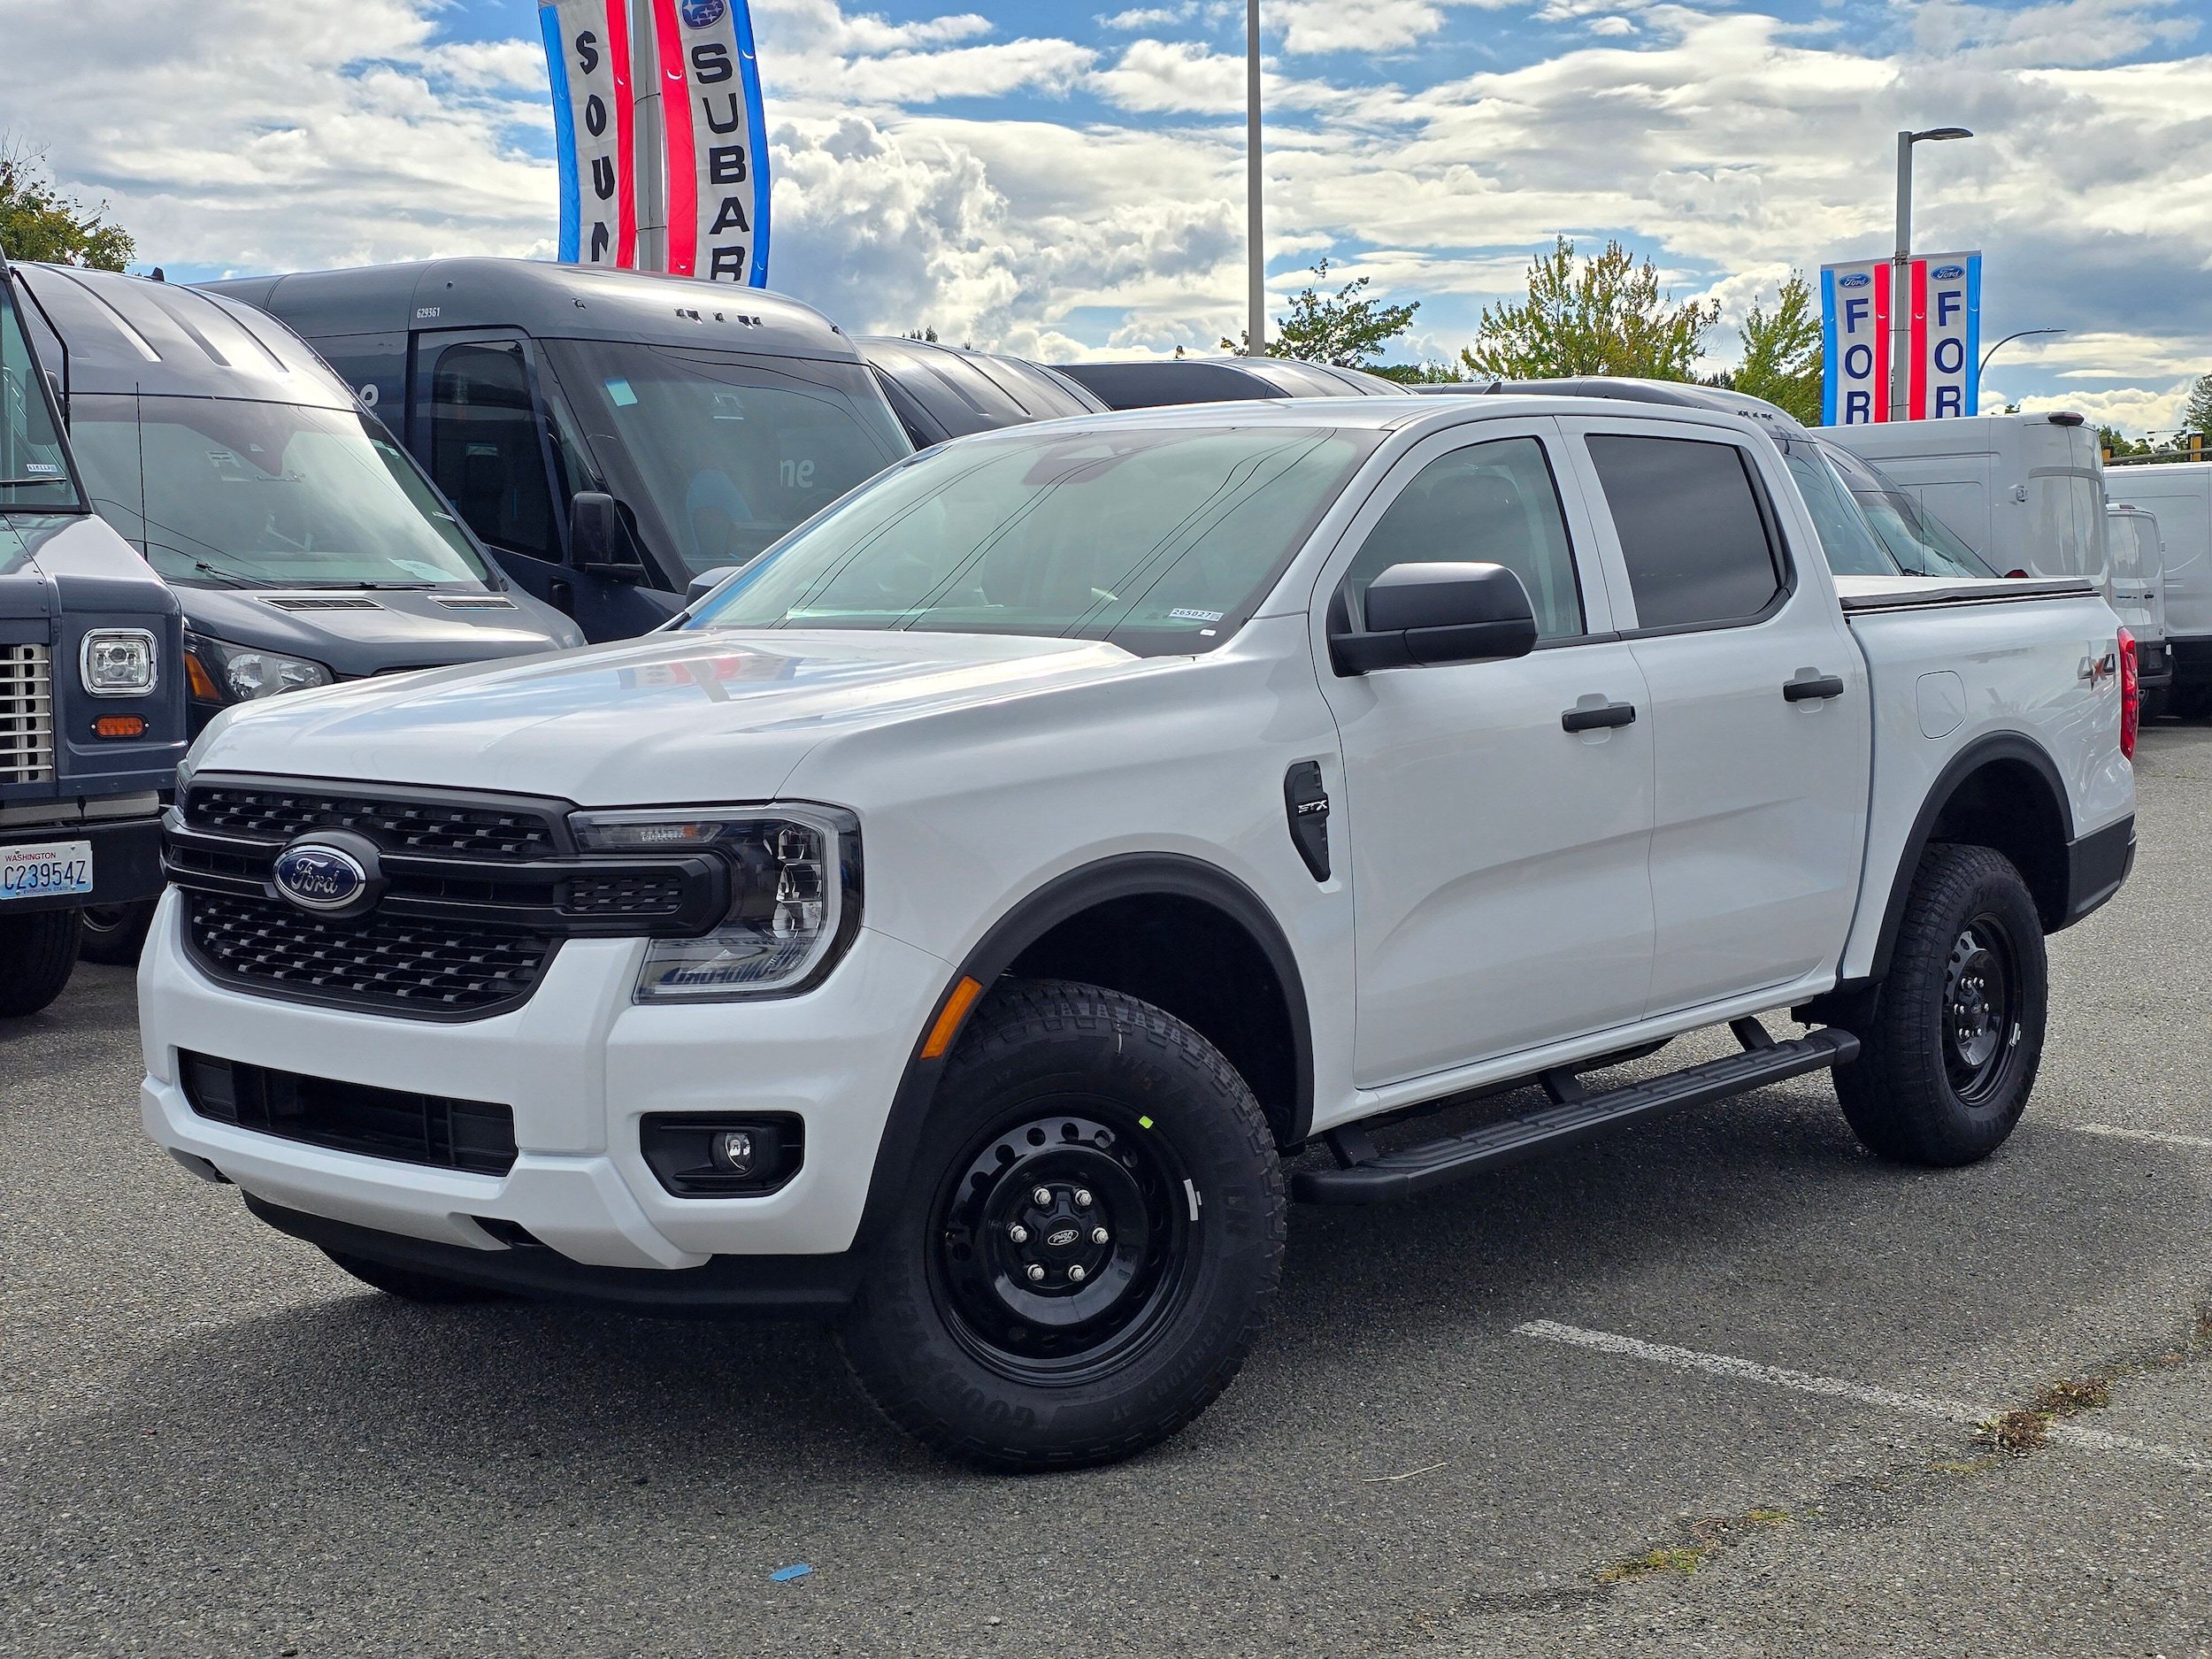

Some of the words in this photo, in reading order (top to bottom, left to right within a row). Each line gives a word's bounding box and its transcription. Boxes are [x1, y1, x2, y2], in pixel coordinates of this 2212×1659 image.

[691, 42, 750, 281] SUBAR
[1937, 267, 1958, 278] Ford
[1844, 275, 1866, 287] Ford
[416, 307, 441, 319] 629361
[1845, 298, 1872, 425] FOR
[1934, 291, 1963, 419] FOR
[1172, 609, 1211, 618] 265027
[1298, 799, 1327, 813] STX
[5, 852, 56, 861] WASHINGTON
[4, 860, 86, 891] C23954Z
[290, 857, 340, 894] Ford
